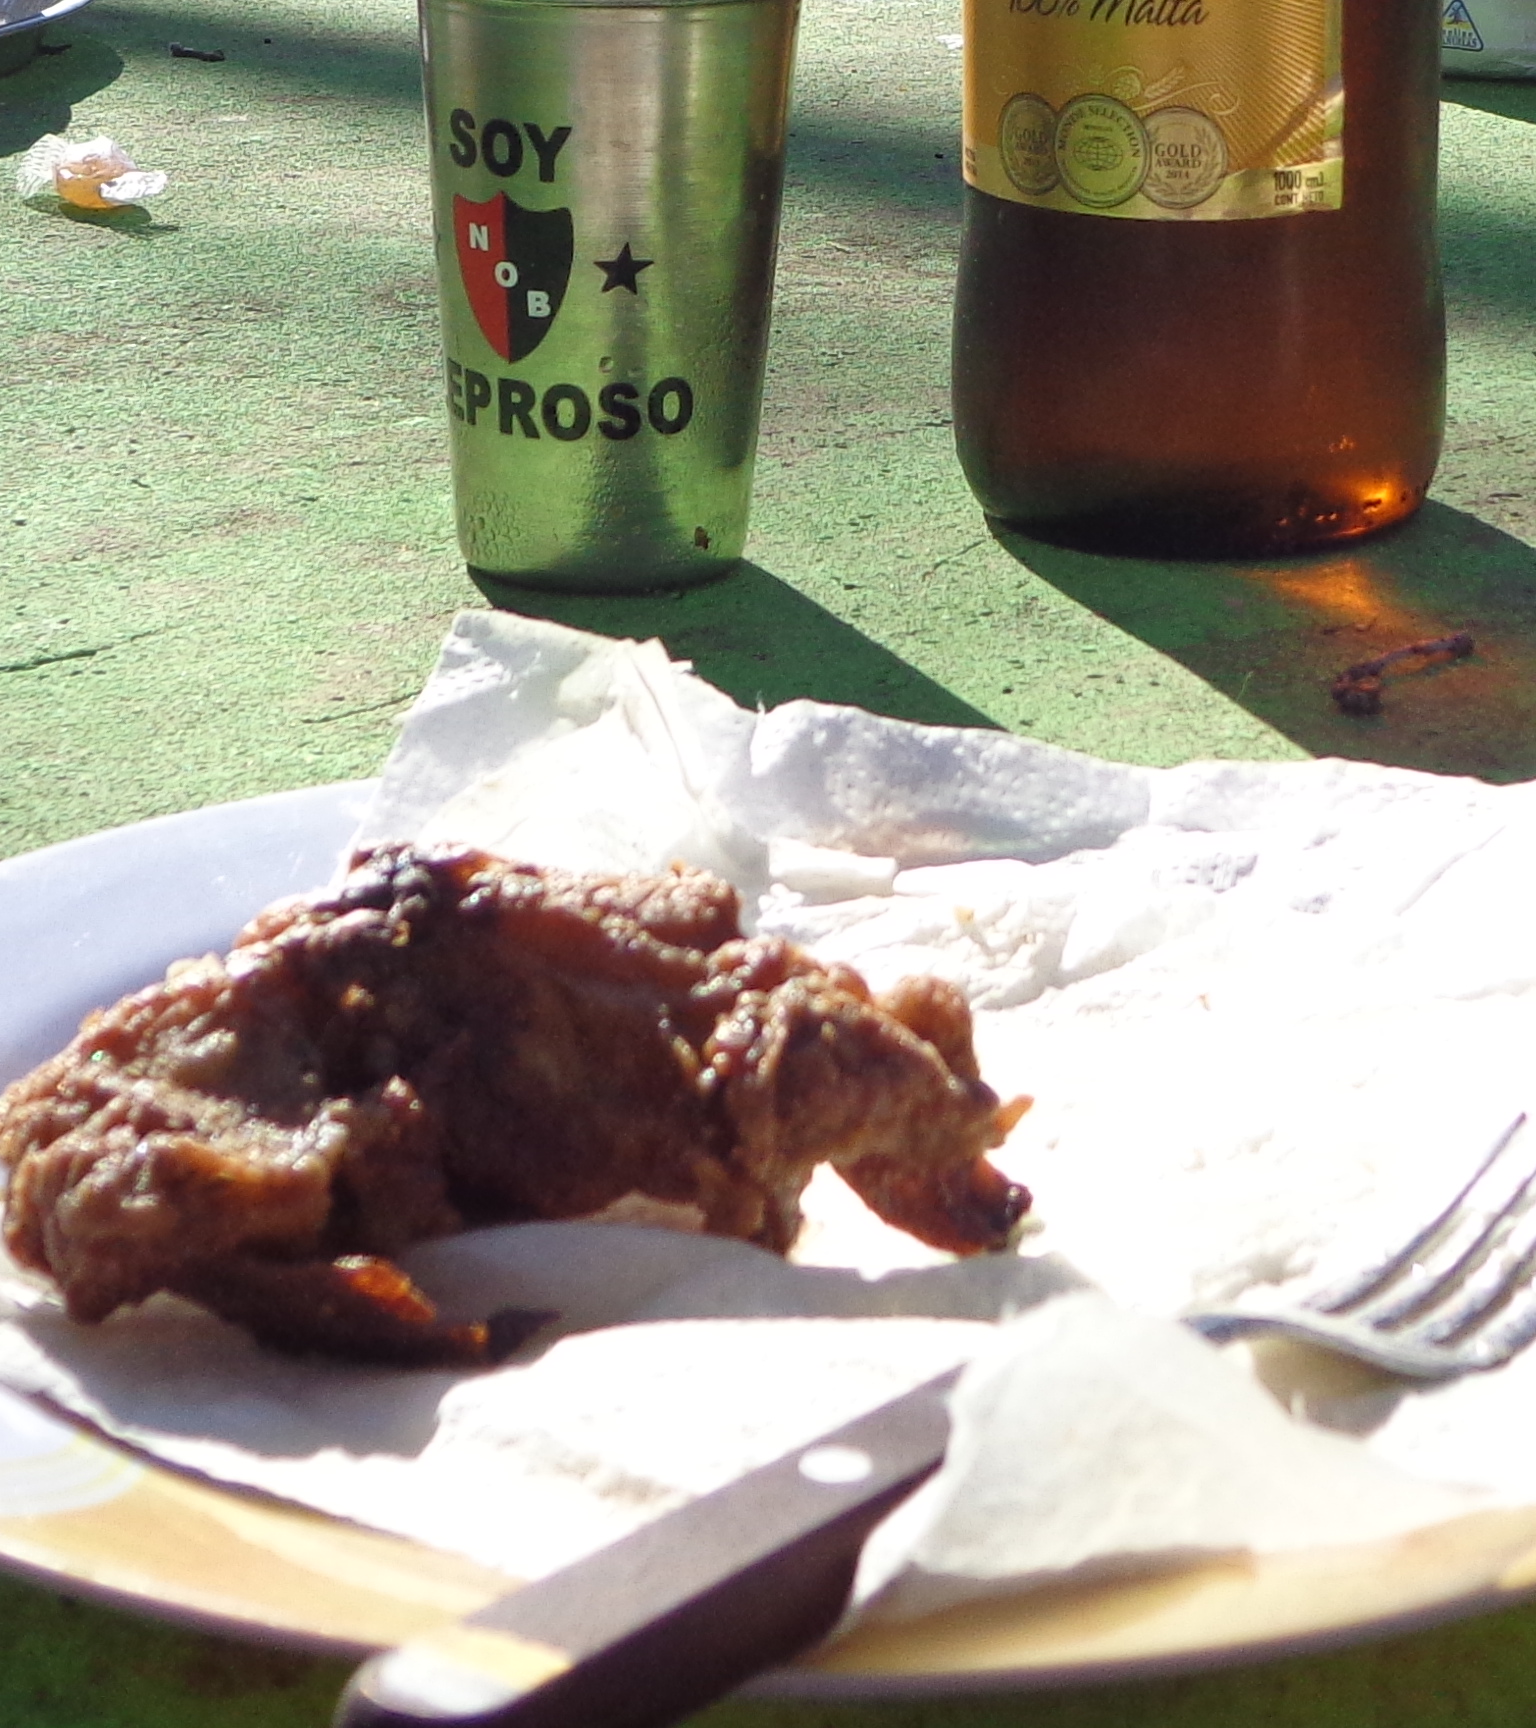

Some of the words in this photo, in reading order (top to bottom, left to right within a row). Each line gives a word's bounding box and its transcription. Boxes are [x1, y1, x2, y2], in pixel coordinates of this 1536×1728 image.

[449, 107, 573, 184] SOY
[1087, 105, 1142, 158] SELECTION
[1154, 143, 1202, 159] GOLD
[1154, 158, 1202, 169] AWARD
[1274, 170, 1302, 191] 1000
[447, 357, 694, 442] EPROSO
